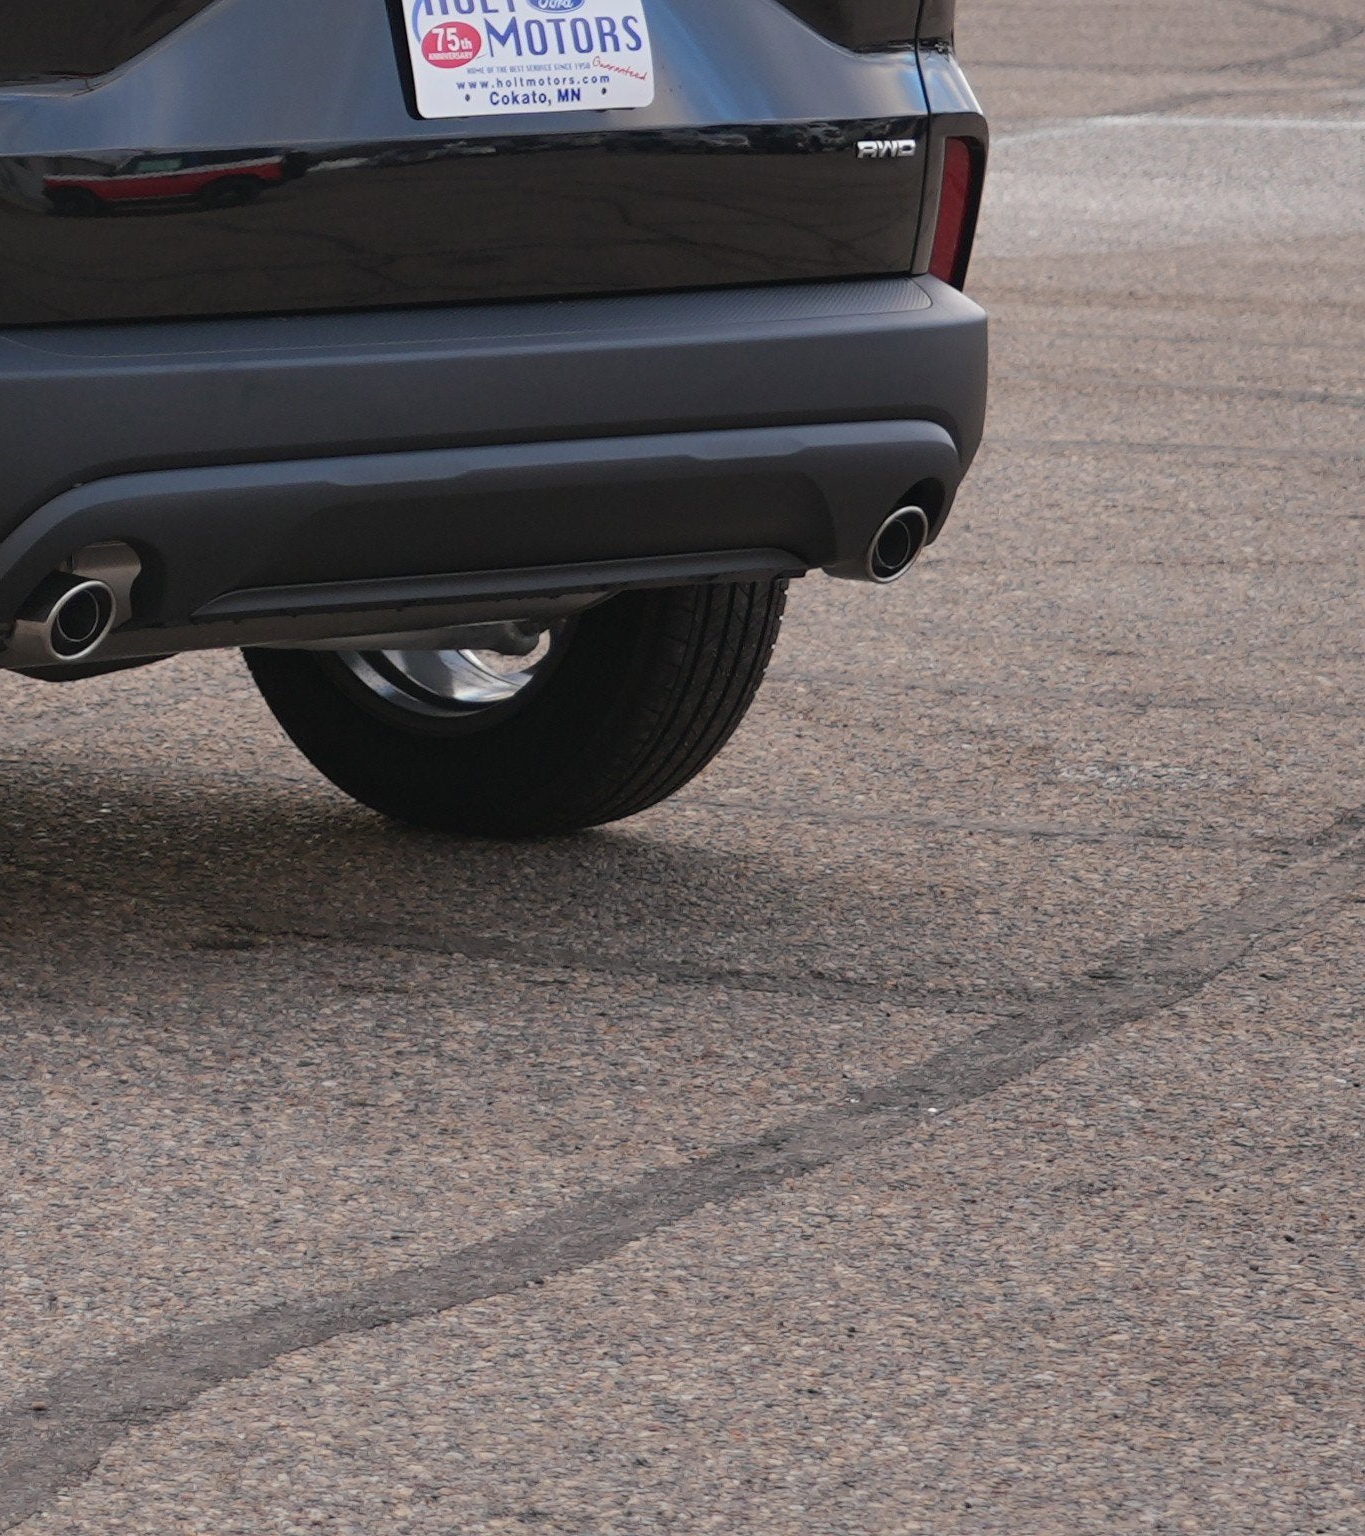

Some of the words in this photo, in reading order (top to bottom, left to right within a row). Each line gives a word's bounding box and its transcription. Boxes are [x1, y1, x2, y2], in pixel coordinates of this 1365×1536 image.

[431, 27, 473, 52] 75th
[484, 15, 642, 58] MOTORS
[456, 75, 610, 89] www.holtmotors.com
[490, 90, 552, 106] Cokato,
[557, 88, 581, 102] MN
[857, 139, 916, 158] AWD
